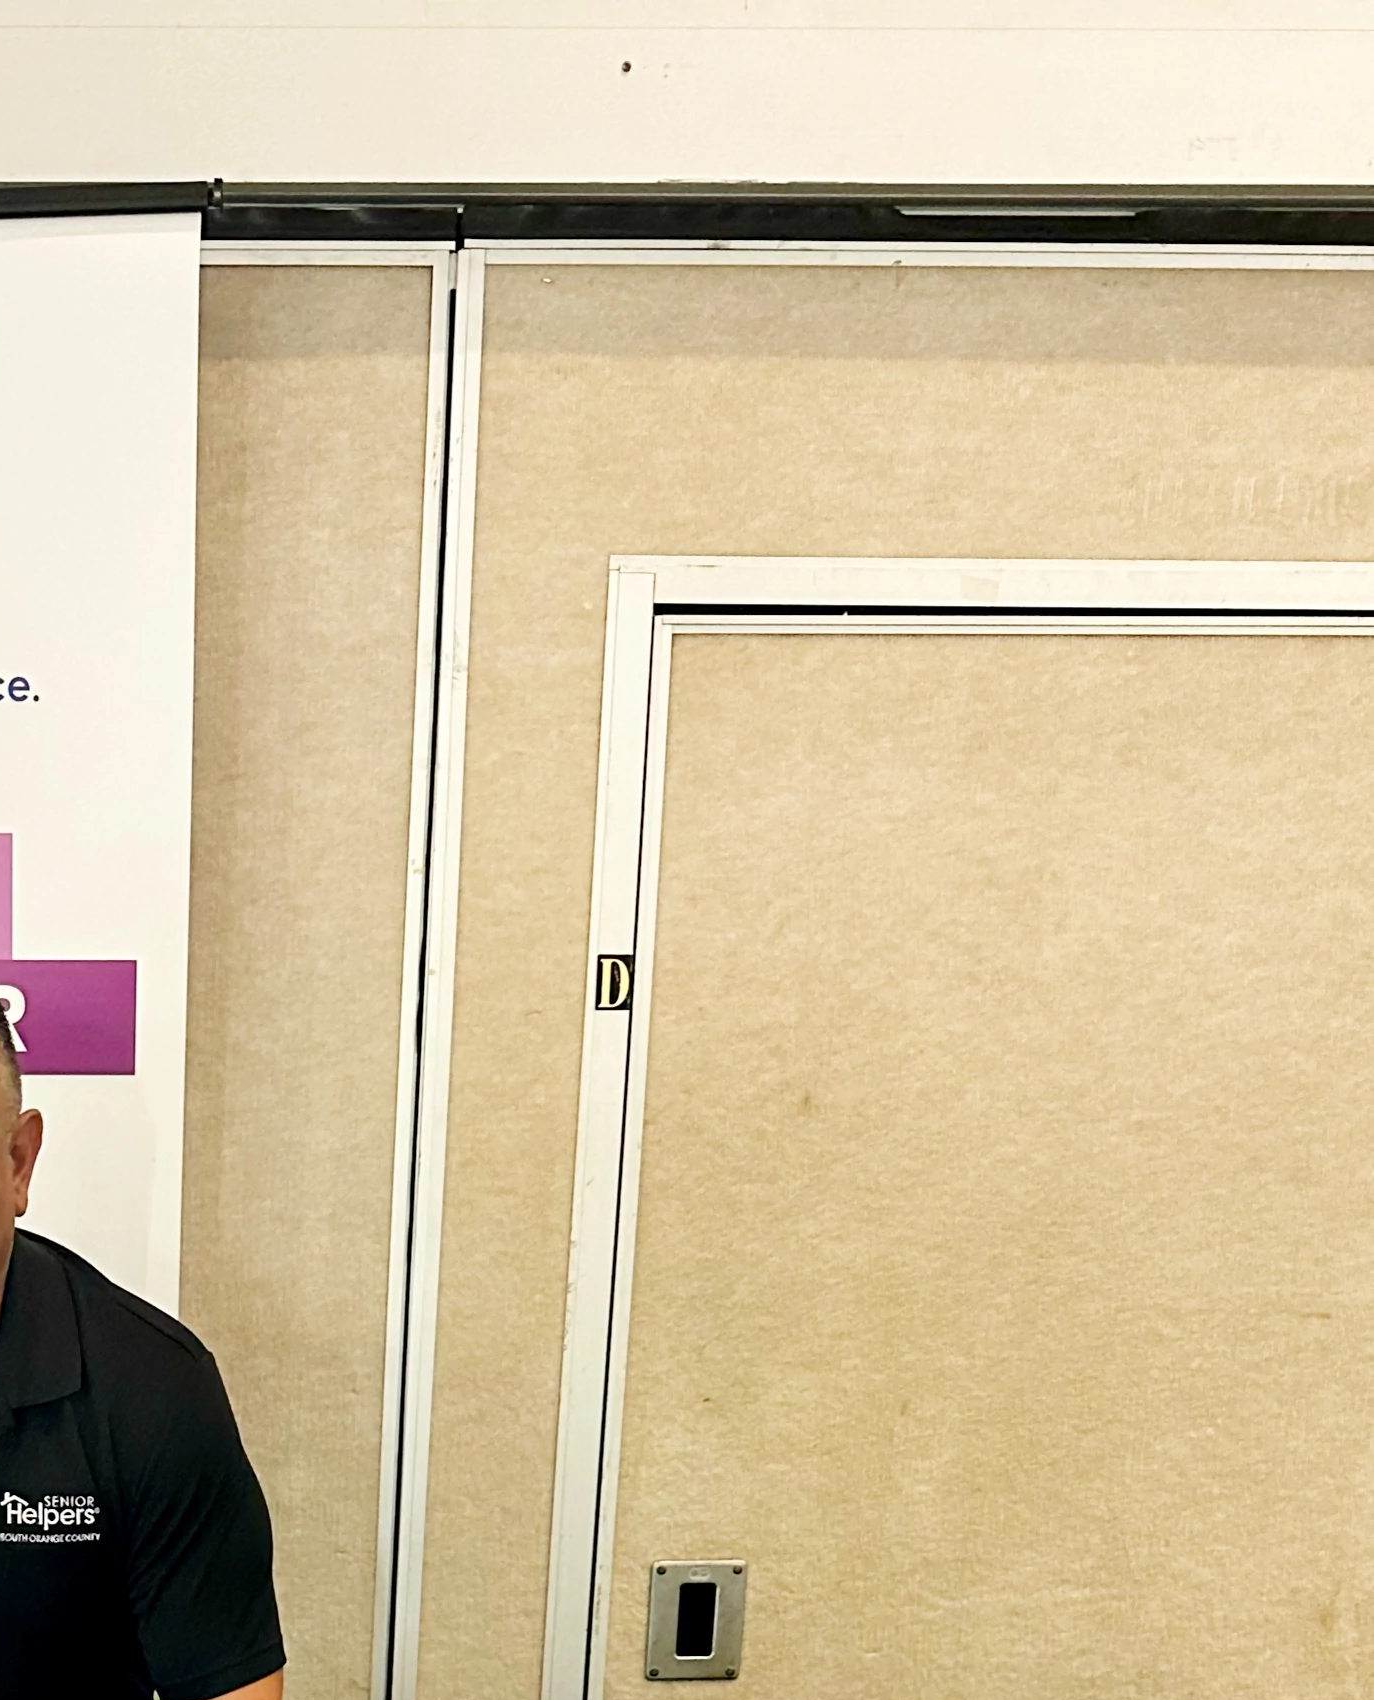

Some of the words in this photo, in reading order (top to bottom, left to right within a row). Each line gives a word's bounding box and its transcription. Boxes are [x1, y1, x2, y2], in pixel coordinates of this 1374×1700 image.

[598, 959, 629, 1007] D
[44, 1496, 94, 1507] SENIOR
[0, 1533, 27, 1542] SOUTH
[28, 1534, 64, 1543] ORANGE
[65, 1533, 100, 1542] COUNTY
